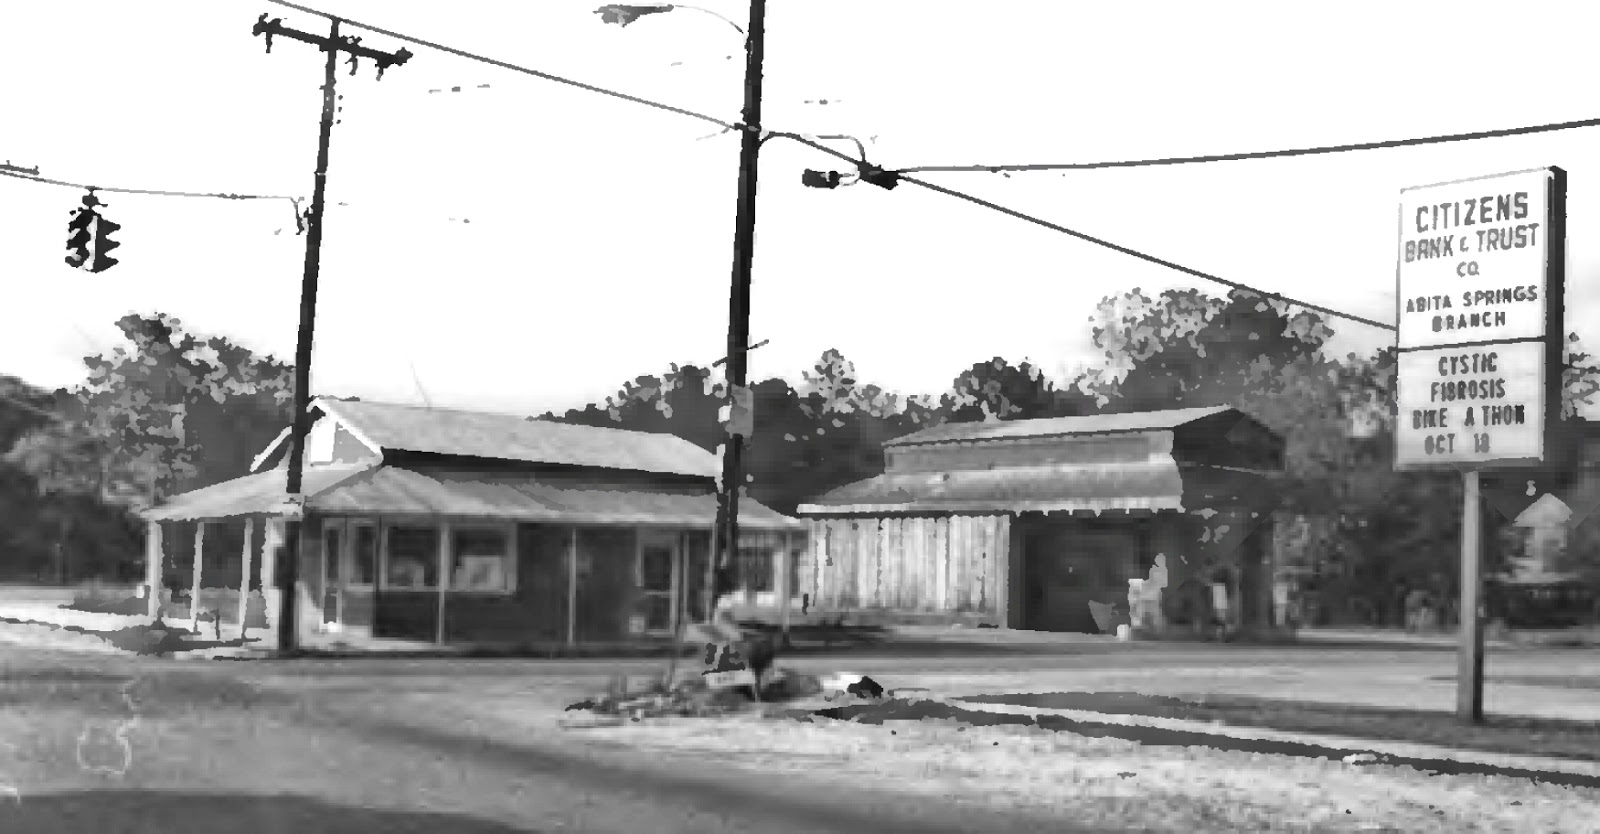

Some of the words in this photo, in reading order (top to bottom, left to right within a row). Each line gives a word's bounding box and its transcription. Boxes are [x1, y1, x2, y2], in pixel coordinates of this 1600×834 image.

[1416, 192, 1528, 233] CITIZENS
[1405, 235, 1454, 263] BANK
[1476, 223, 1540, 252] TRUST
[1406, 294, 1452, 313] ABITA
[1463, 284, 1538, 307] SPRINGS
[1432, 311, 1505, 332] BRANCH
[1438, 352, 1498, 376] CYSTIC
[1430, 377, 1505, 403] FIBROSIS
[1412, 407, 1448, 430] BIKE
[1464, 406, 1475, 426] A
[1481, 404, 1525, 426] THON
[1424, 433, 1455, 455] OCT
